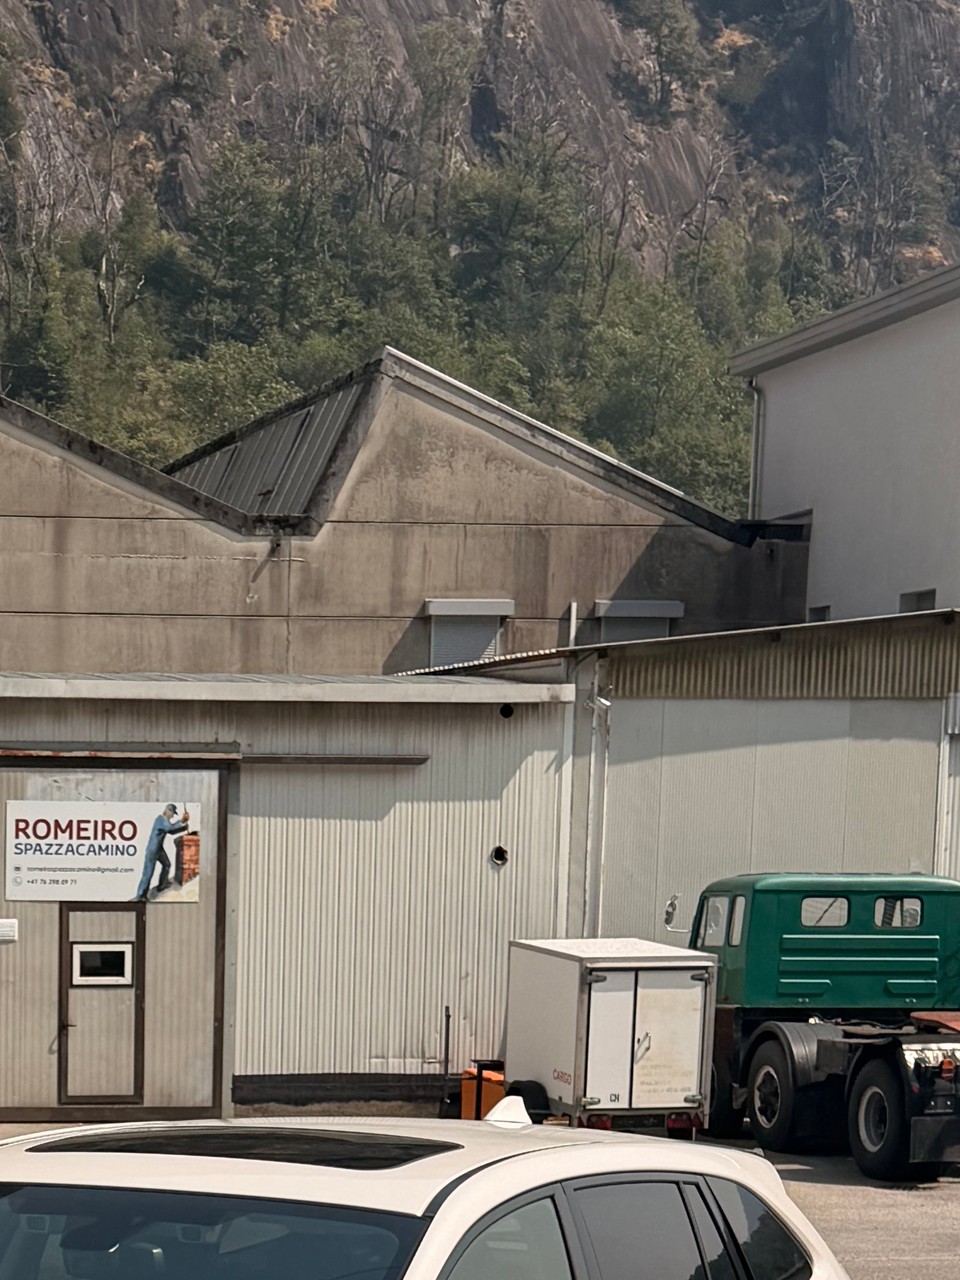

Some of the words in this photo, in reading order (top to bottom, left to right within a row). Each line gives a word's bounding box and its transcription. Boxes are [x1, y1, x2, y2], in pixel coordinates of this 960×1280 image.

[14, 818, 138, 842] ROMEIRO
[14, 842, 138, 857] SPAZZACAMINO
[552, 1068, 572, 1086] CARGO
